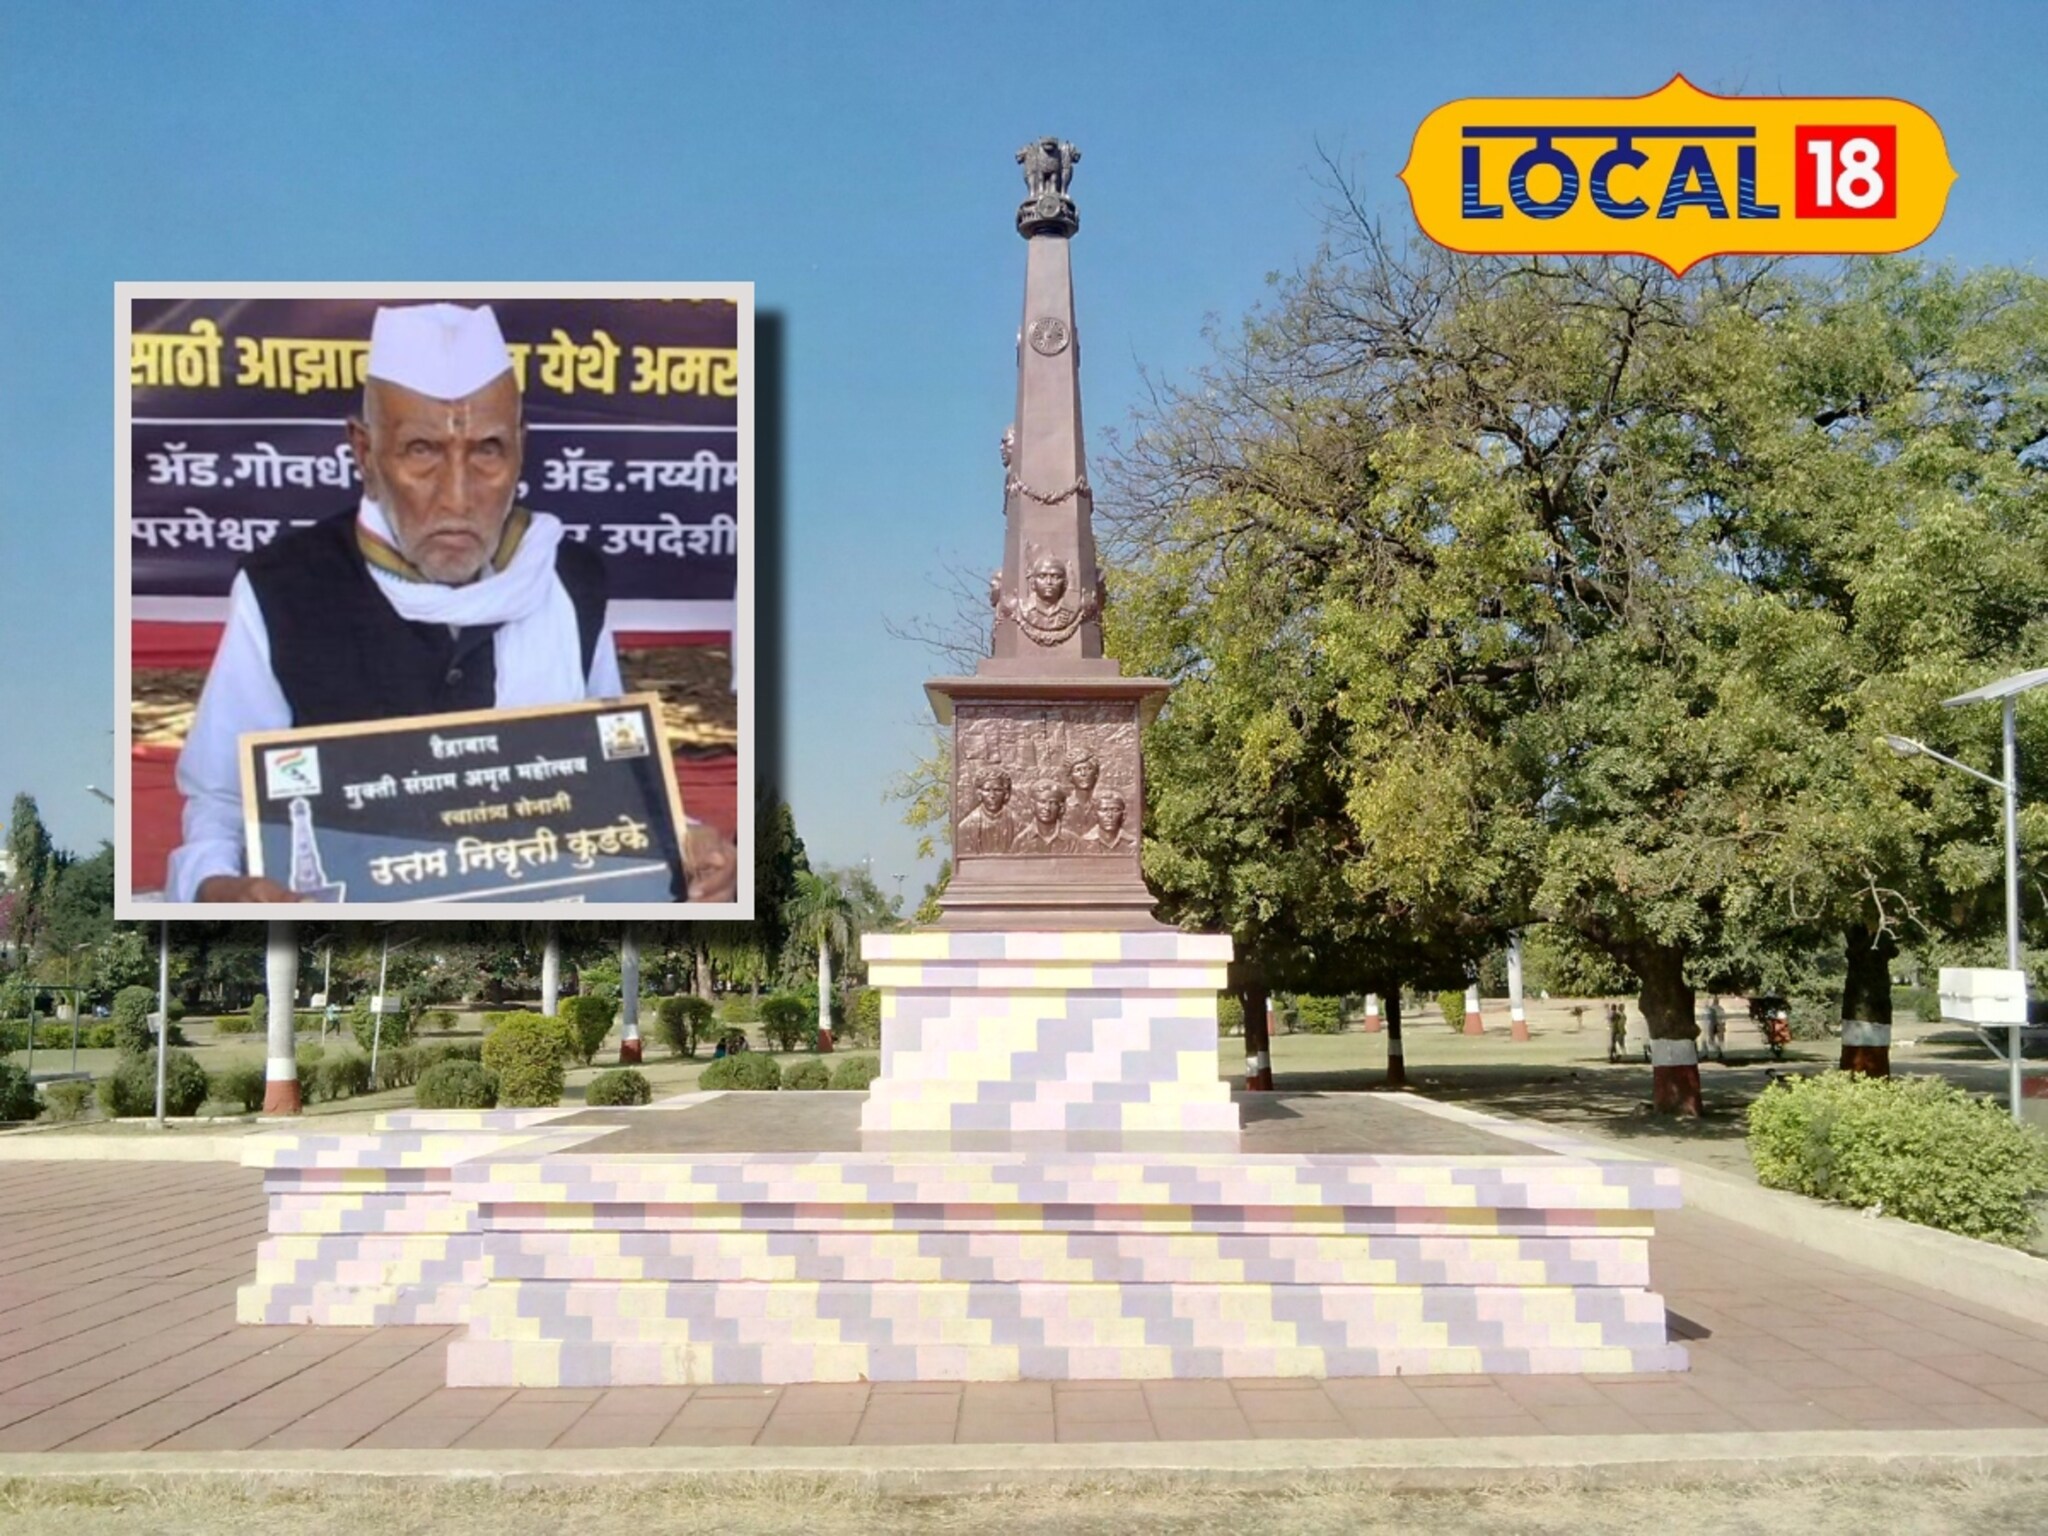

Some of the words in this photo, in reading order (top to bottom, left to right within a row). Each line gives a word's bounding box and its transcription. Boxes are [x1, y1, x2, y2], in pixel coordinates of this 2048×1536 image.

[537, 329, 620, 394] येथे
[131, 507, 280, 552] परमेश्वर
[343, 774, 398, 810] मुक्ती
[402, 769, 457, 794] संग्राम
[464, 765, 511, 792] अमृत
[514, 755, 588, 781] महोत्सव
[369, 849, 447, 885] उत्तम
[455, 827, 558, 879] निवृत्ती
[565, 815, 649, 869] कुडके
